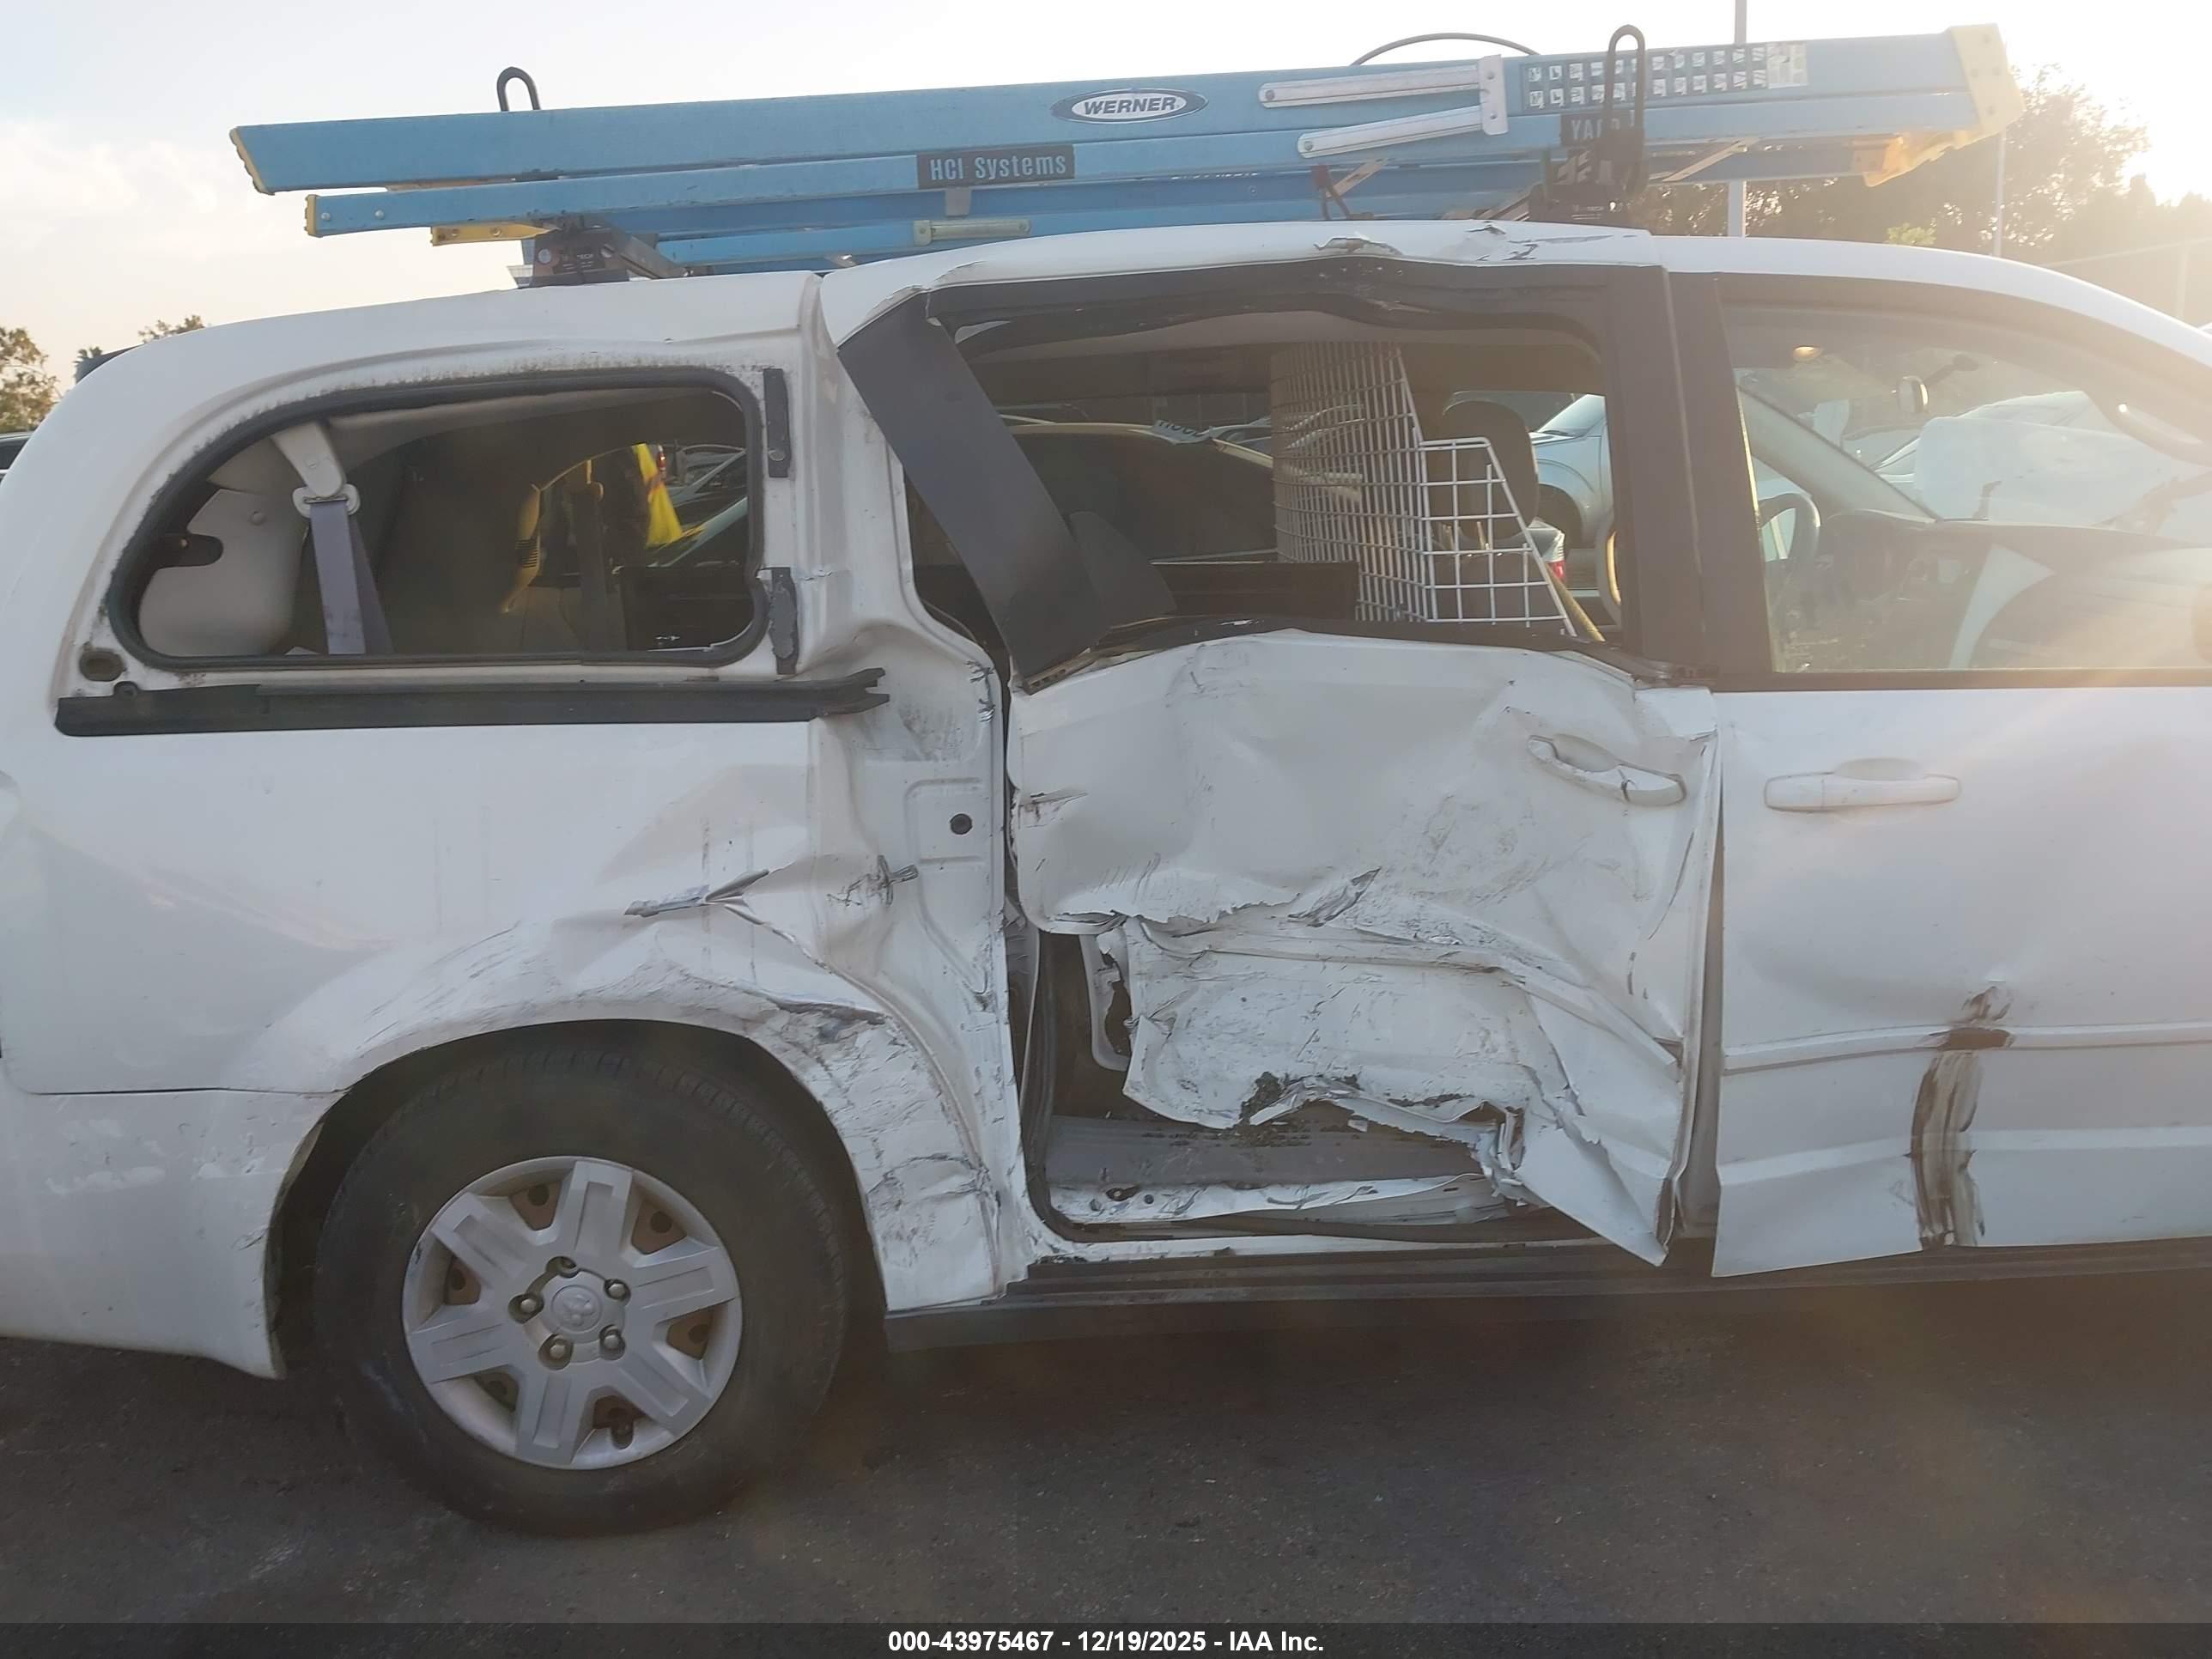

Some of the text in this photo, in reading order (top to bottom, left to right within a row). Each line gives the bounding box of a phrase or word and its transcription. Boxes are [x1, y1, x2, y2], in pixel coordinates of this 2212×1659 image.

[1084, 96, 1176, 115] WERNER
[930, 155, 1066, 180] HCI Systems
